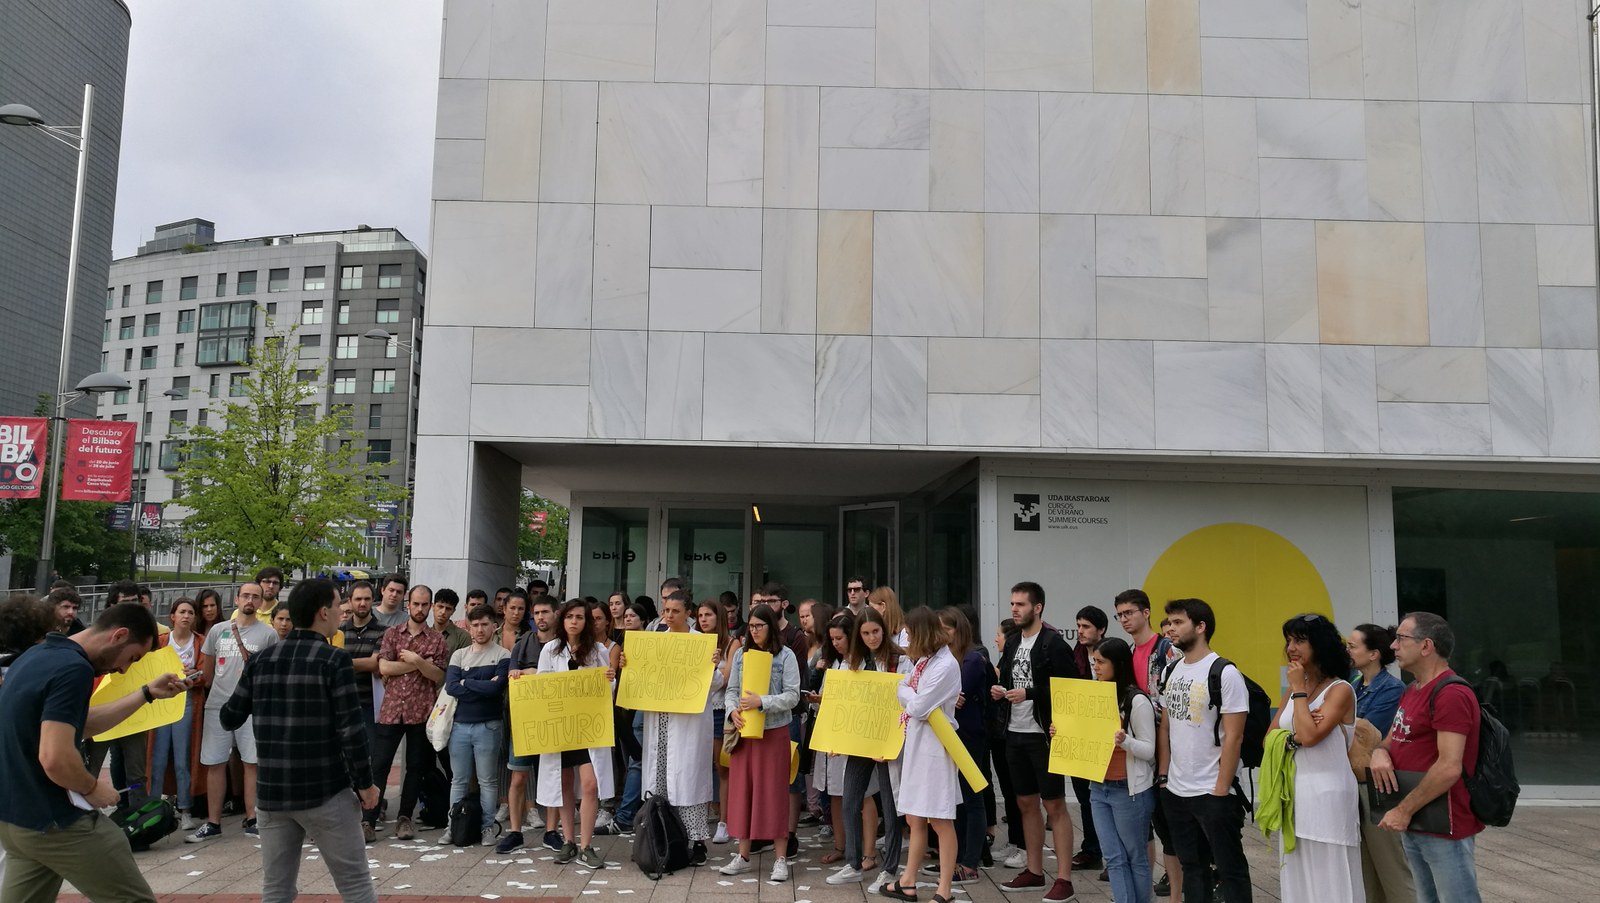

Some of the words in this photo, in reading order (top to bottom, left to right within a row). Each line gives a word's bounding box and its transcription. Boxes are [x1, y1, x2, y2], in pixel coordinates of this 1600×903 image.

[0, 424, 34, 445] BIL
[82, 428, 122, 436] Descubre
[92, 437, 121, 445] Bilbao
[95, 446, 122, 454] futuro
[1064, 495, 1110, 503] IKASTAROAK
[592, 551, 620, 560] bbk
[684, 552, 712, 561] bbk
[632, 635, 708, 666] UPV/EHU
[514, 670, 606, 701] INVESTIGACIÓN
[626, 661, 703, 700] PÁGANOS
[831, 704, 892, 742] DIGNA
[522, 713, 606, 751] FUTURO
